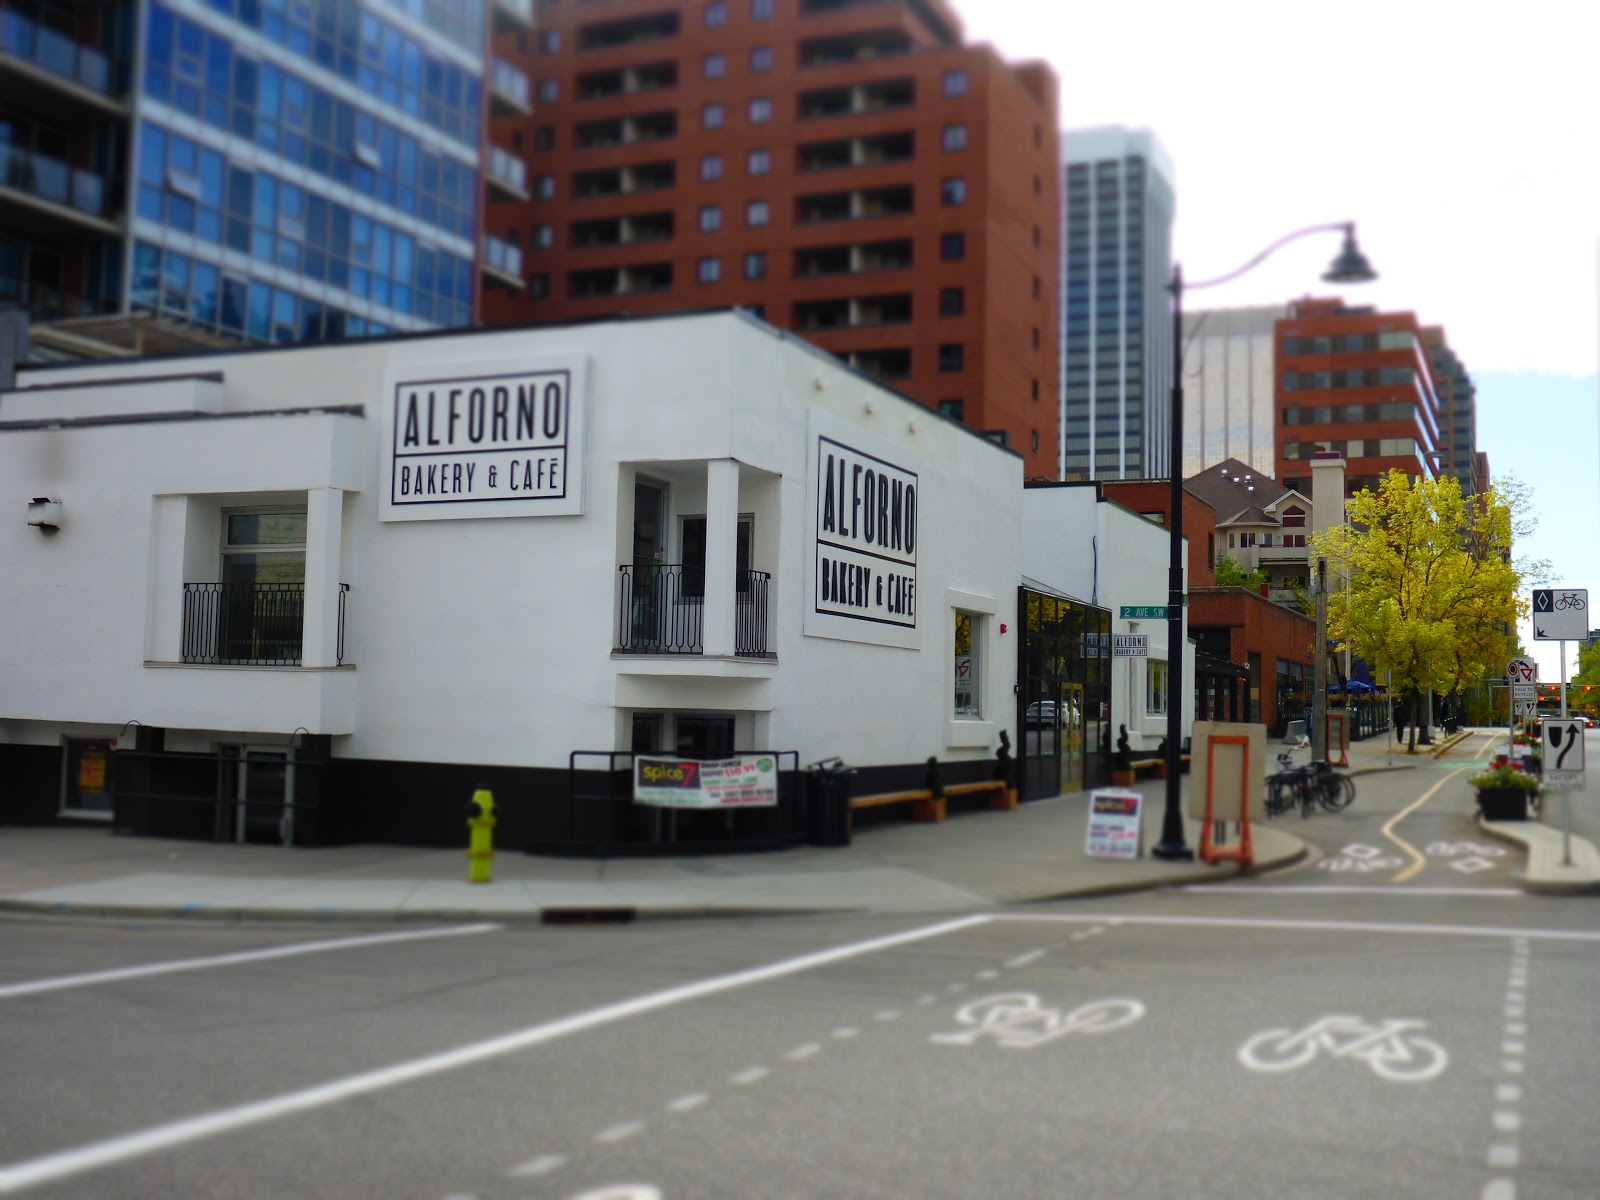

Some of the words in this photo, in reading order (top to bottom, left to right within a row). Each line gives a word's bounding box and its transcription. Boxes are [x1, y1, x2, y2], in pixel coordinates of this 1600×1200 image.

[404, 382, 561, 447] ALFORNO
[401, 462, 476, 496] BAKERY
[488, 465, 497, 488] &
[823, 454, 915, 555] ALFORNO
[822, 557, 871, 608] BAKERY
[876, 575, 883, 606] &
[1124, 607, 1131, 617] 2
[1135, 607, 1149, 617] AVE
[1153, 607, 1165, 617] SW
[1116, 637, 1146, 647] ALFORNO
